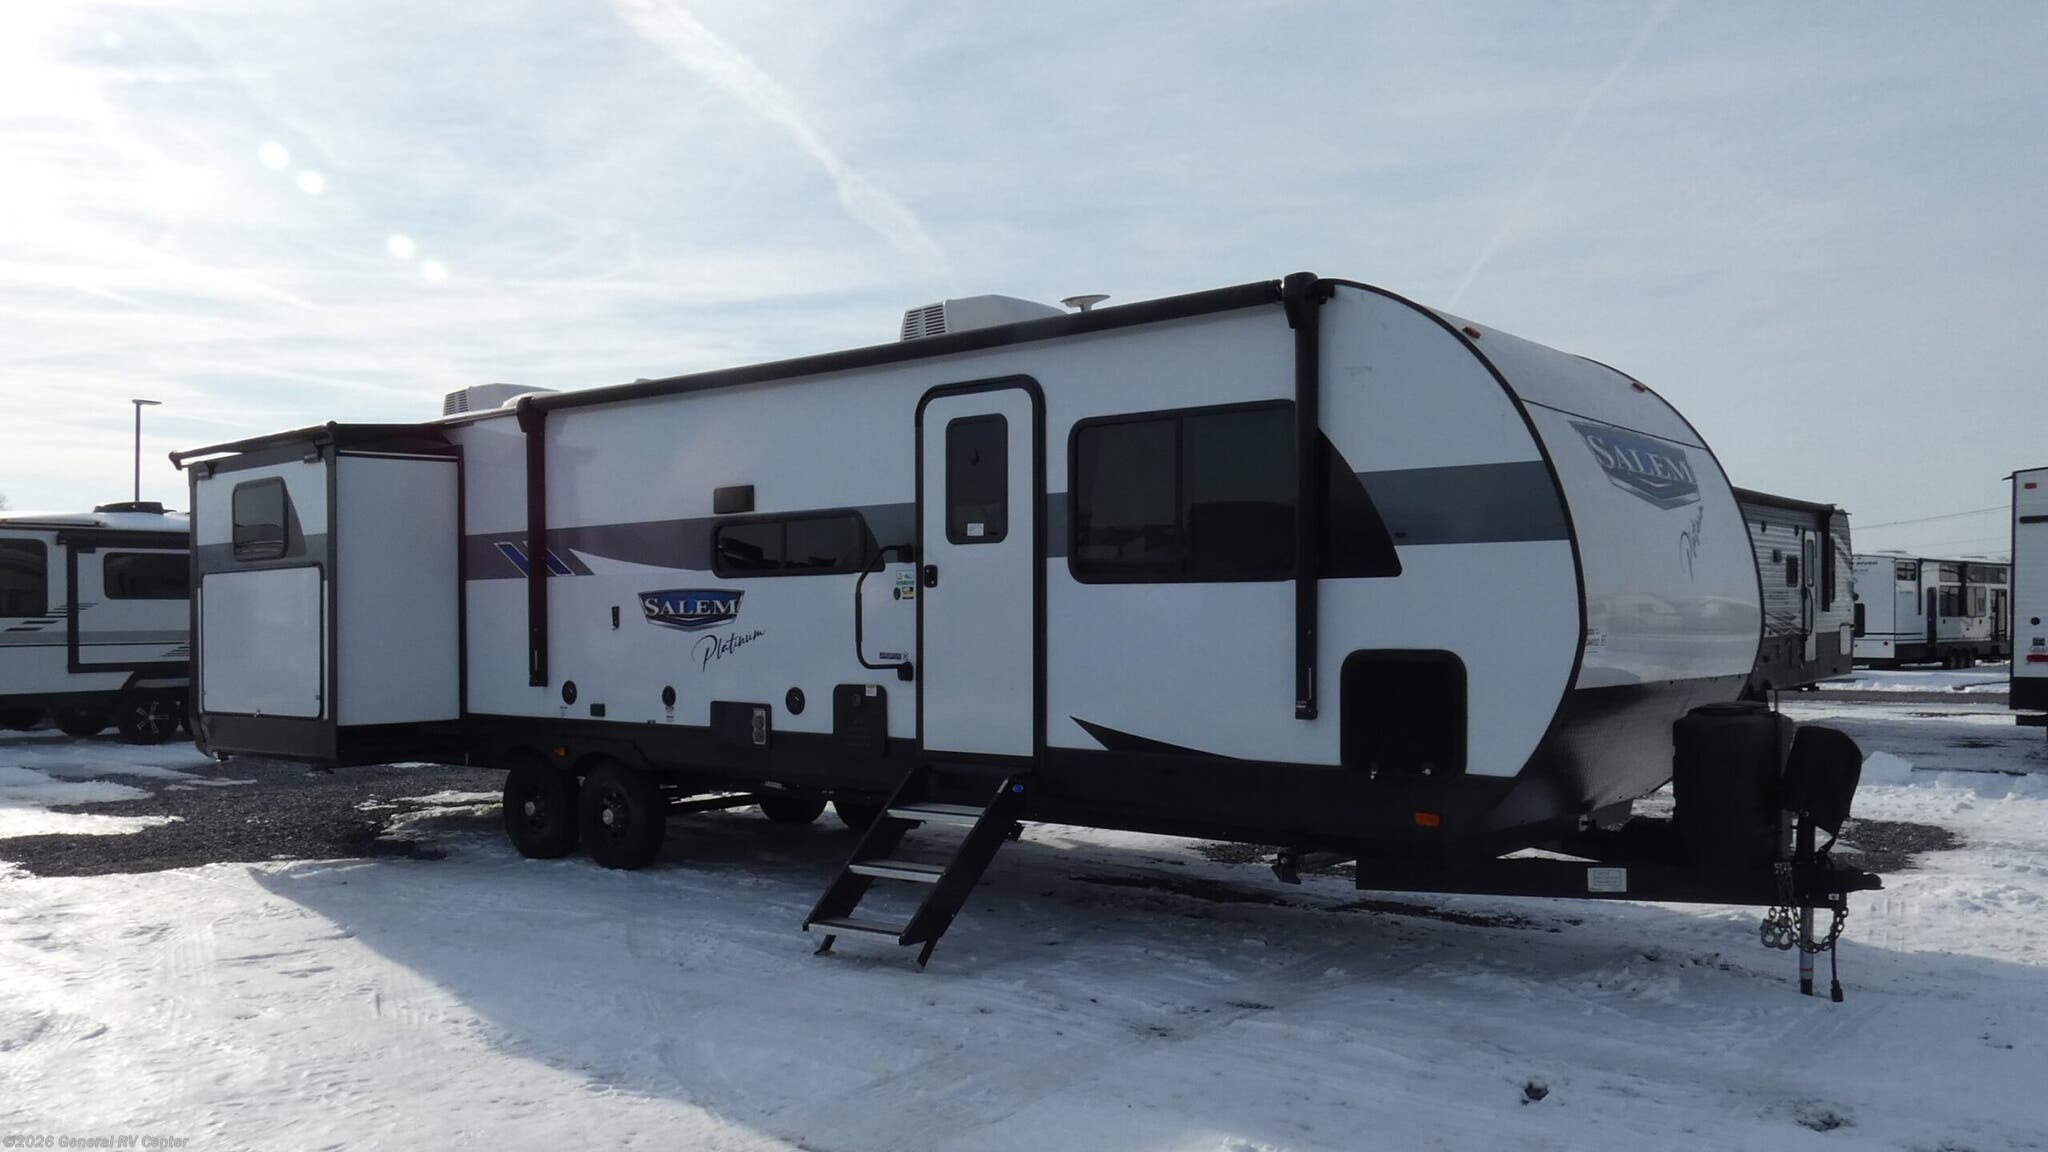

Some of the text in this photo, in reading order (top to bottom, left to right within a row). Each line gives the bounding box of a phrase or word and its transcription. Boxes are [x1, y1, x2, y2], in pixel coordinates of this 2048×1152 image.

[1586, 434, 1697, 484] SALEM
[644, 597, 739, 617] SALEM
[691, 629, 766, 672] Platinum
